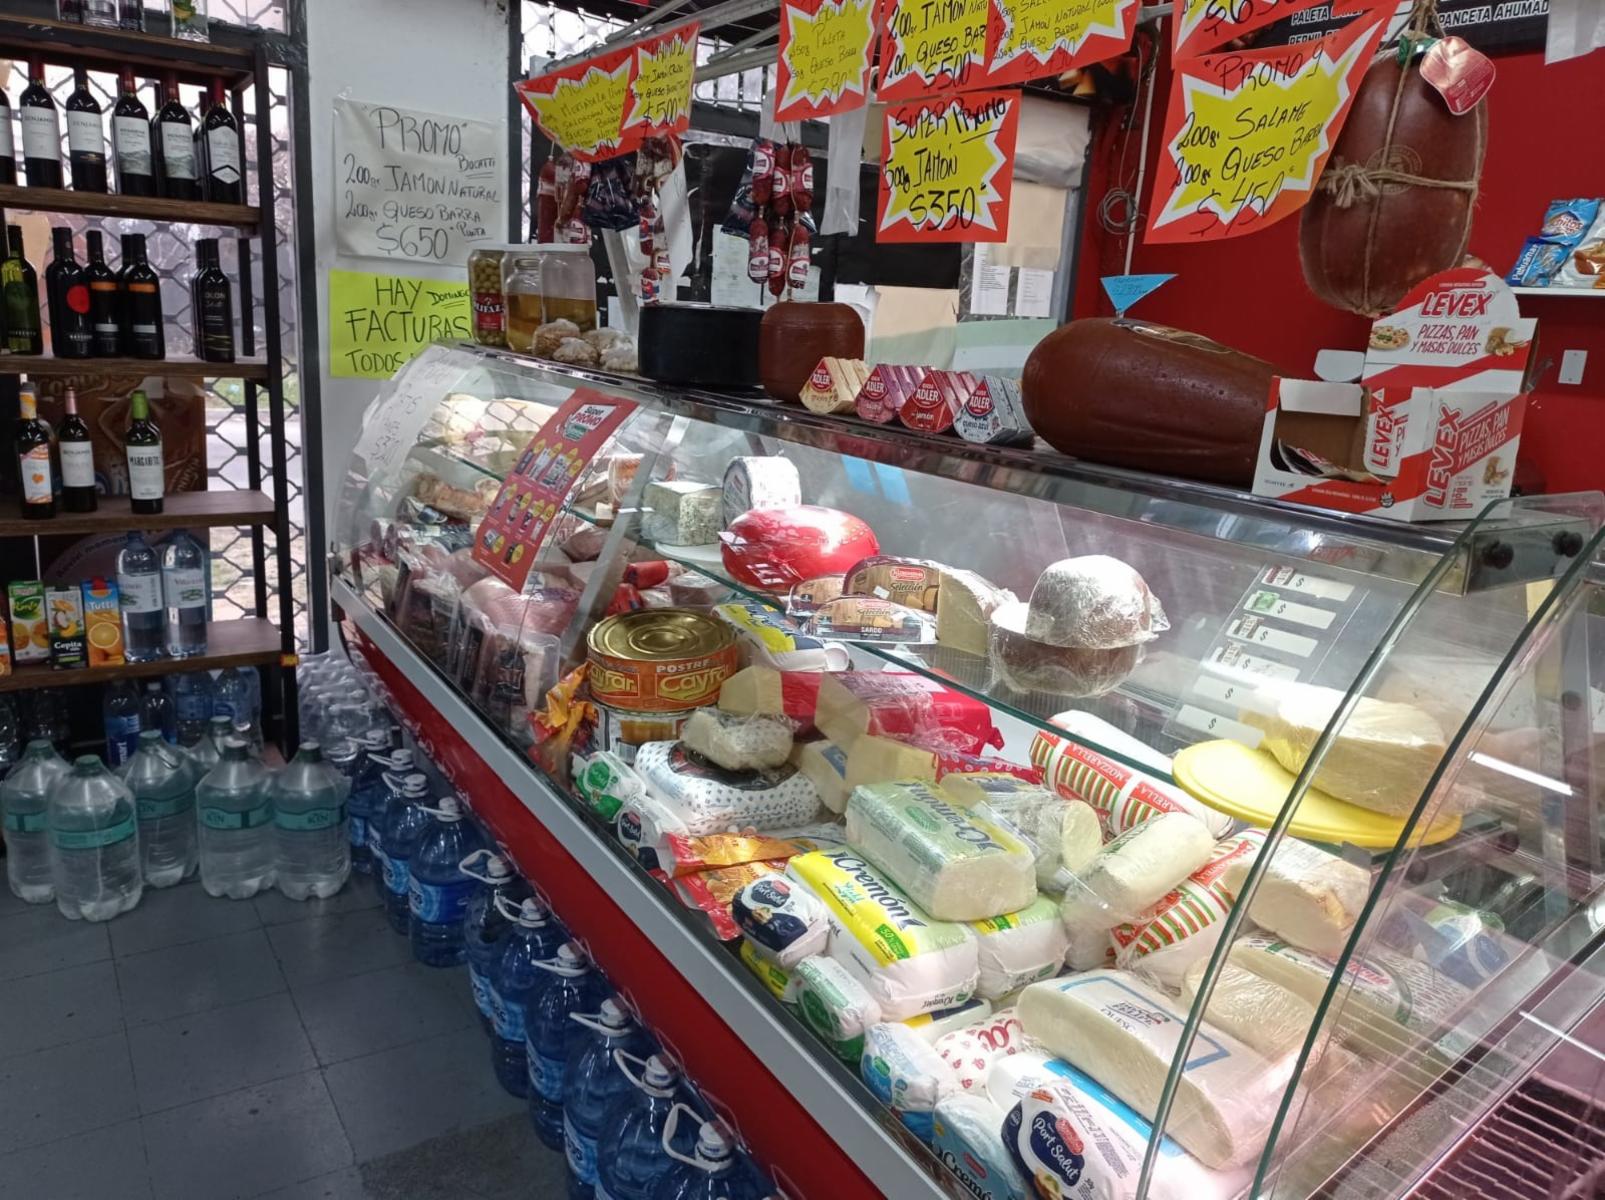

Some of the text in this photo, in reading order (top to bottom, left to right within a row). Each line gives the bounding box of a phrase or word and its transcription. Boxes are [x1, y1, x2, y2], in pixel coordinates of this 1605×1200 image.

[1290, 5, 1331, 26] PALETA
[1439, 10, 1491, 26] PANCETA
[917, 35, 958, 64] QUESO
[892, 97, 1006, 143] SUPER PROMO
[1229, 101, 1312, 140] SALAME
[1221, 146, 1286, 181] QUESO
[384, 165, 446, 195] JAMON
[448, 179, 499, 203] NATURAL
[383, 200, 434, 224] QUESO
[439, 204, 481, 224] BARRA
[376, 278, 423, 309] HAY
[1421, 291, 1494, 318] LEVEX
[345, 307, 473, 343] FACTURAS
[1457, 326, 1480, 339] PAN
[1418, 341, 1447, 354] MASAS
[1446, 342, 1481, 355] DULCES
[345, 349, 404, 373] TODOS
[812, 374, 831, 386] ADLER
[866, 381, 885, 393] ADLER
[915, 388, 938, 402] ADLER
[969, 396, 990, 410] ADLER
[1372, 405, 1398, 468] LEVEX
[1424, 402, 1462, 508] LEVEX
[1296, 577, 1304, 587] $
[1278, 603, 1286, 614] $
[1260, 630, 1268, 641] $
[54, 641, 82, 653] Cepita
[656, 659, 710, 673] POSTRE
[1225, 687, 1233, 699] $
[1209, 718, 1217, 729] $
[834, 855, 911, 924] Cremón
[1032, 1116, 1079, 1181] Port Salut
